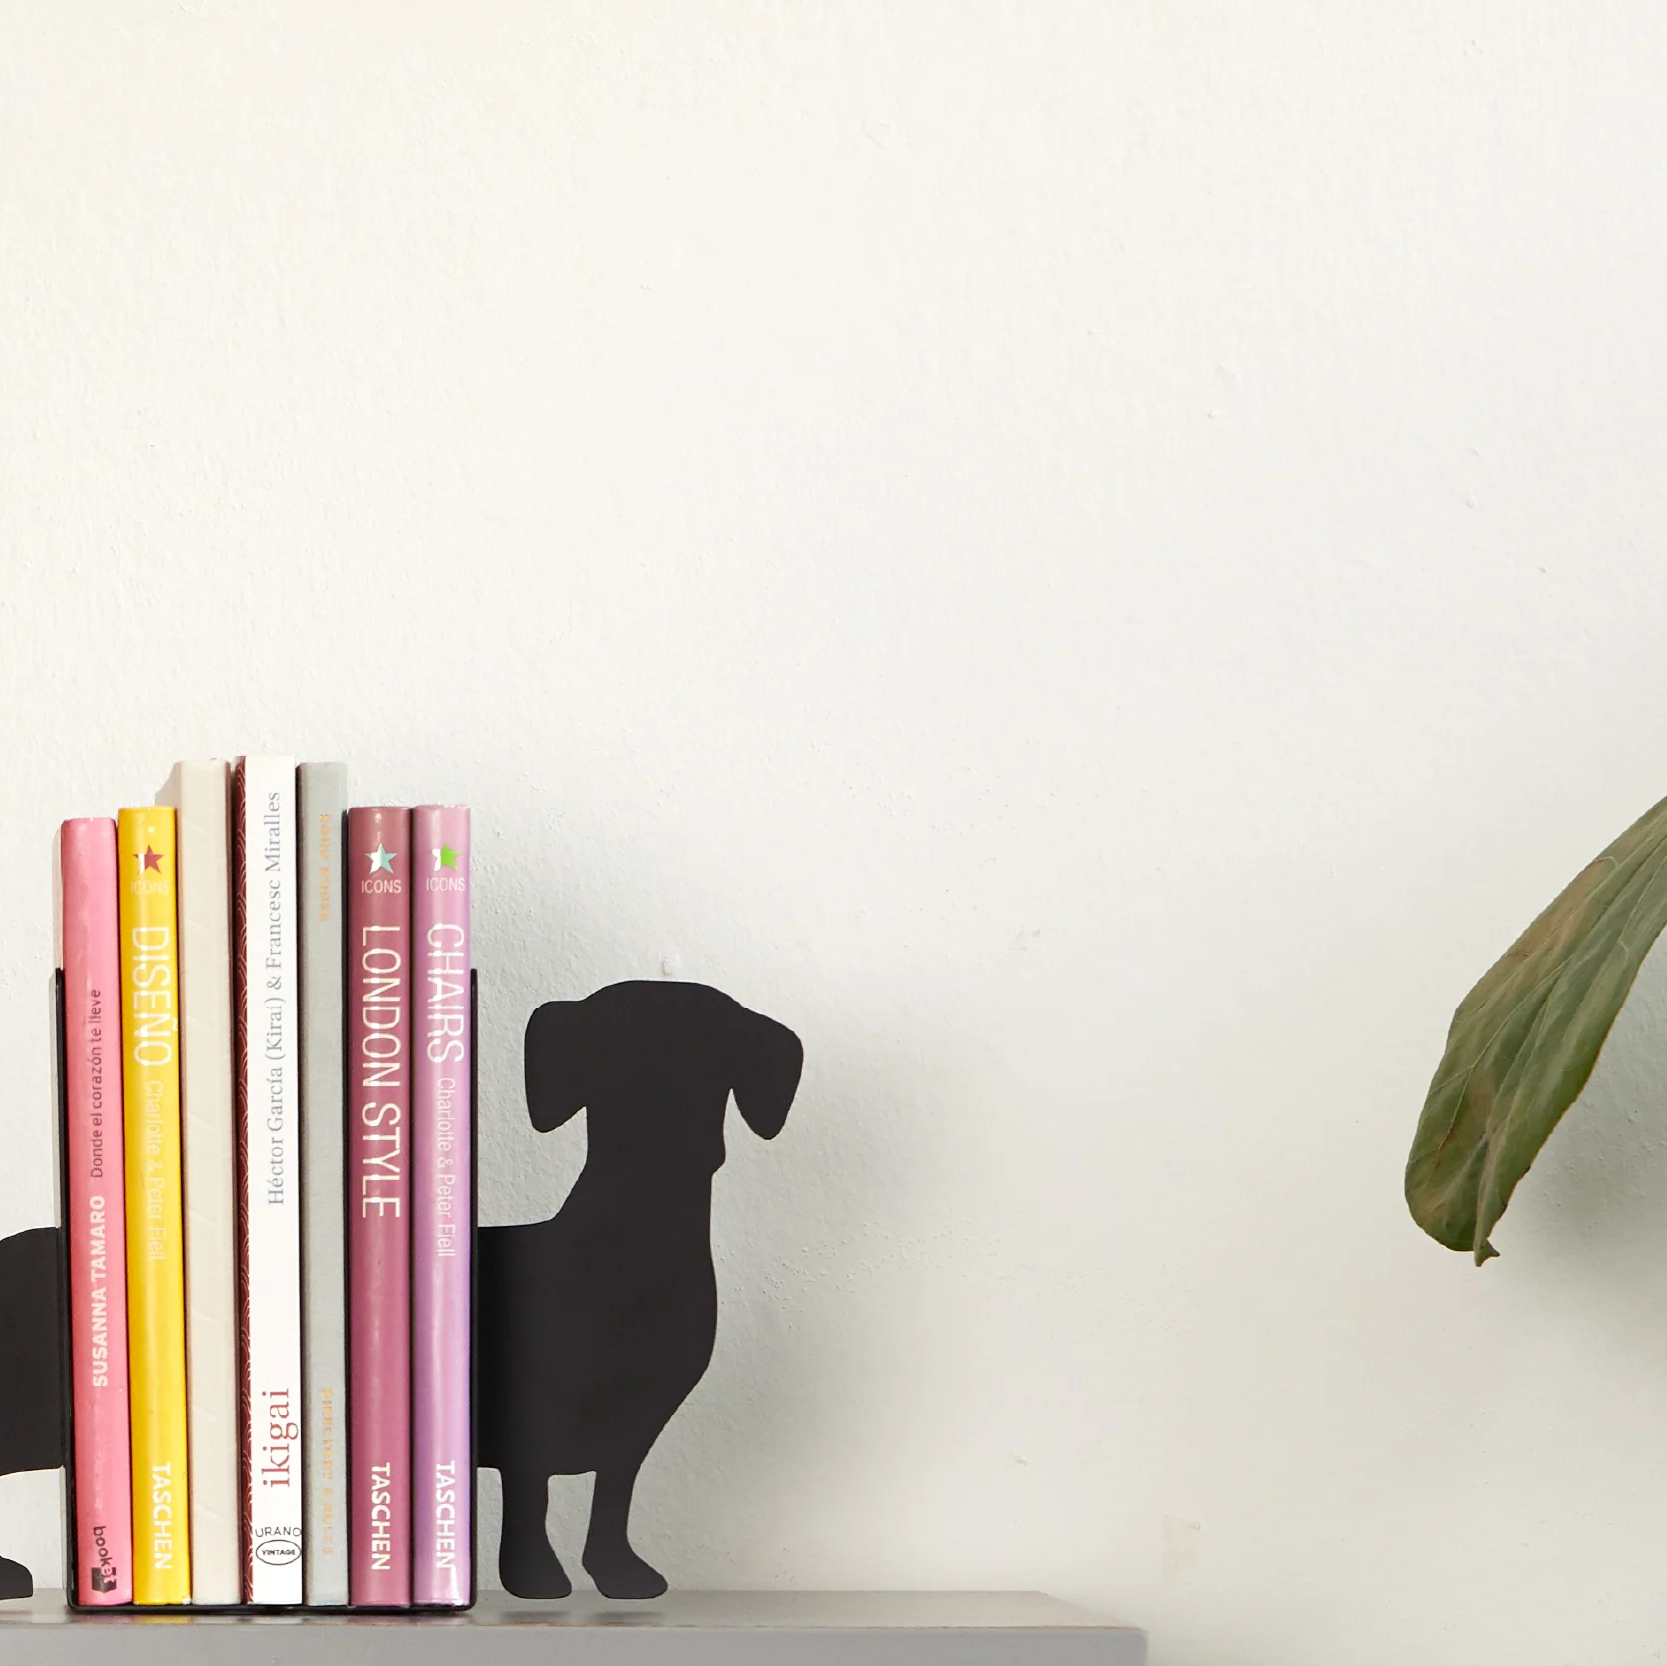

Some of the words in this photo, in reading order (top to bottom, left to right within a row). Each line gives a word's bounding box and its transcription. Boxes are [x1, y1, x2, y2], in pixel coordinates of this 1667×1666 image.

[264, 792, 280, 872] Miralles
[131, 879, 170, 895] ICONS
[361, 879, 401, 894] ICONS
[426, 877, 465, 891] ICONS
[266, 880, 281, 970] Francesc
[88, 989, 101, 1024] lleve
[132, 926, 178, 1067] DISEÑO
[267, 976, 282, 990] &
[362, 925, 401, 1087] LONDON
[426, 923, 465, 1063] CHAIRS
[90, 1028, 102, 1043] te
[264, 997, 286, 1060] (Kirai)
[87, 1047, 102, 1109] corazón
[266, 1067, 283, 1131] García
[90, 1114, 102, 1126] el
[145, 1081, 164, 1154] Charlotte
[437, 1077, 456, 1151] Charlotte
[90, 1131, 103, 1178] Donde
[147, 1160, 162, 1171] &
[268, 1138, 284, 1204] Héctor
[362, 1101, 401, 1218] STYLE
[437, 1158, 453, 1168] &
[147, 1177, 165, 1221] Peter
[437, 1174, 455, 1218] Peter
[89, 1195, 107, 1283] TAMARO
[148, 1227, 166, 1261] Fiell
[437, 1224, 456, 1257] Fiell
[91, 1288, 108, 1387] SUSANNA
[261, 1388, 299, 1487] ikigai
[152, 1462, 172, 1569] TASCHEN
[255, 1526, 301, 1538] URANO
[371, 1462, 391, 1571] TASCHEN
[435, 1461, 456, 1569] TASCHEN
[93, 1526, 117, 1584] booket
